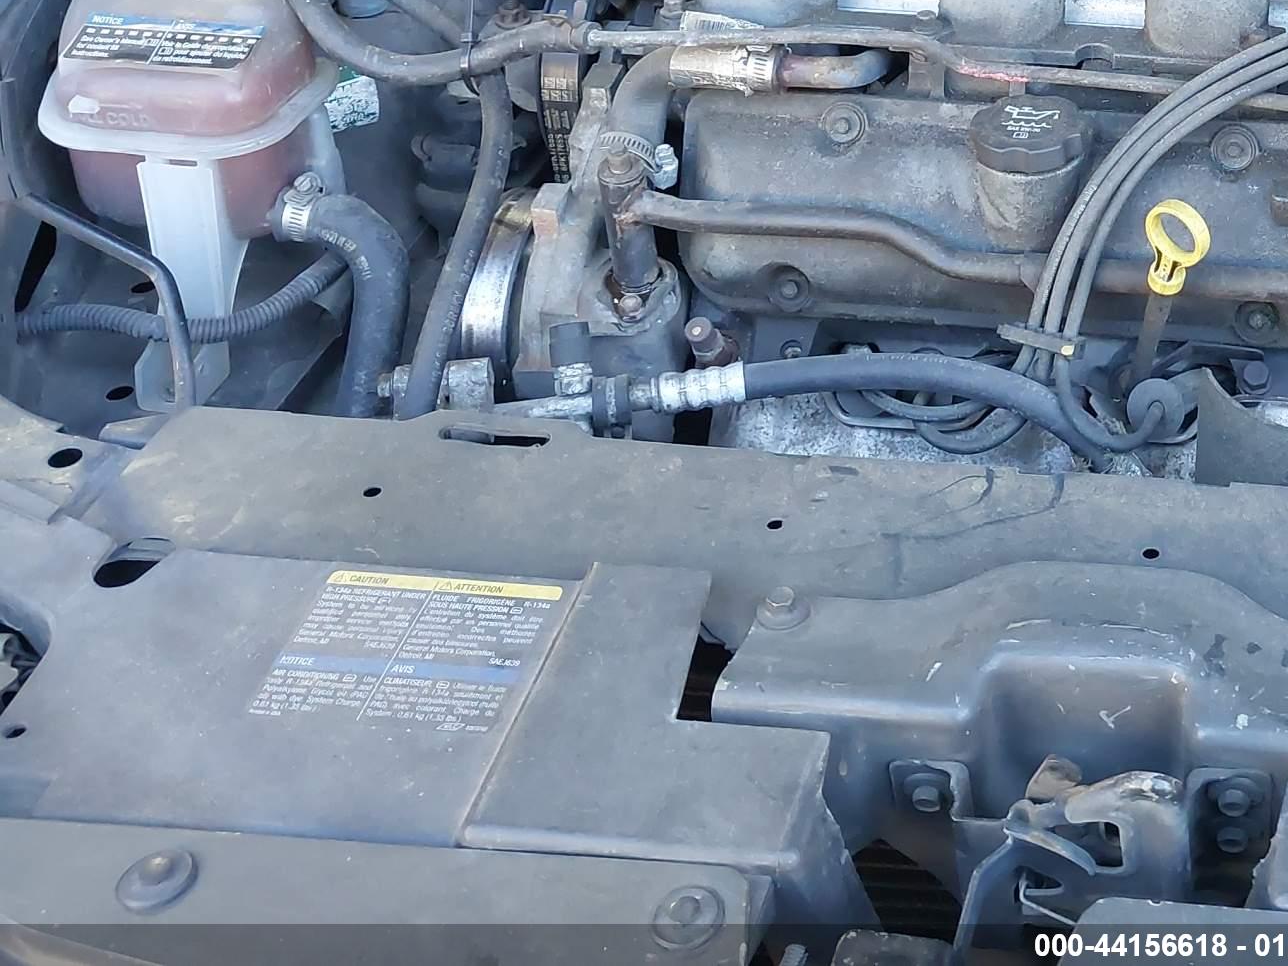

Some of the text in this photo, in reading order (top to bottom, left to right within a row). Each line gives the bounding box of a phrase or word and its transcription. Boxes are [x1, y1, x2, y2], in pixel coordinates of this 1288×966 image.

[92, 15, 124, 25] NOTICE
[349, 574, 390, 585] CAUTION
[453, 584, 504, 594] ATTENTION
[432, 593, 459, 602] FLUIDE
[473, 604, 509, 613] PRESSION
[279, 655, 316, 666] NOTICE
[390, 665, 415, 674] AVIS
[287, 670, 340, 681] CONDITIONING
